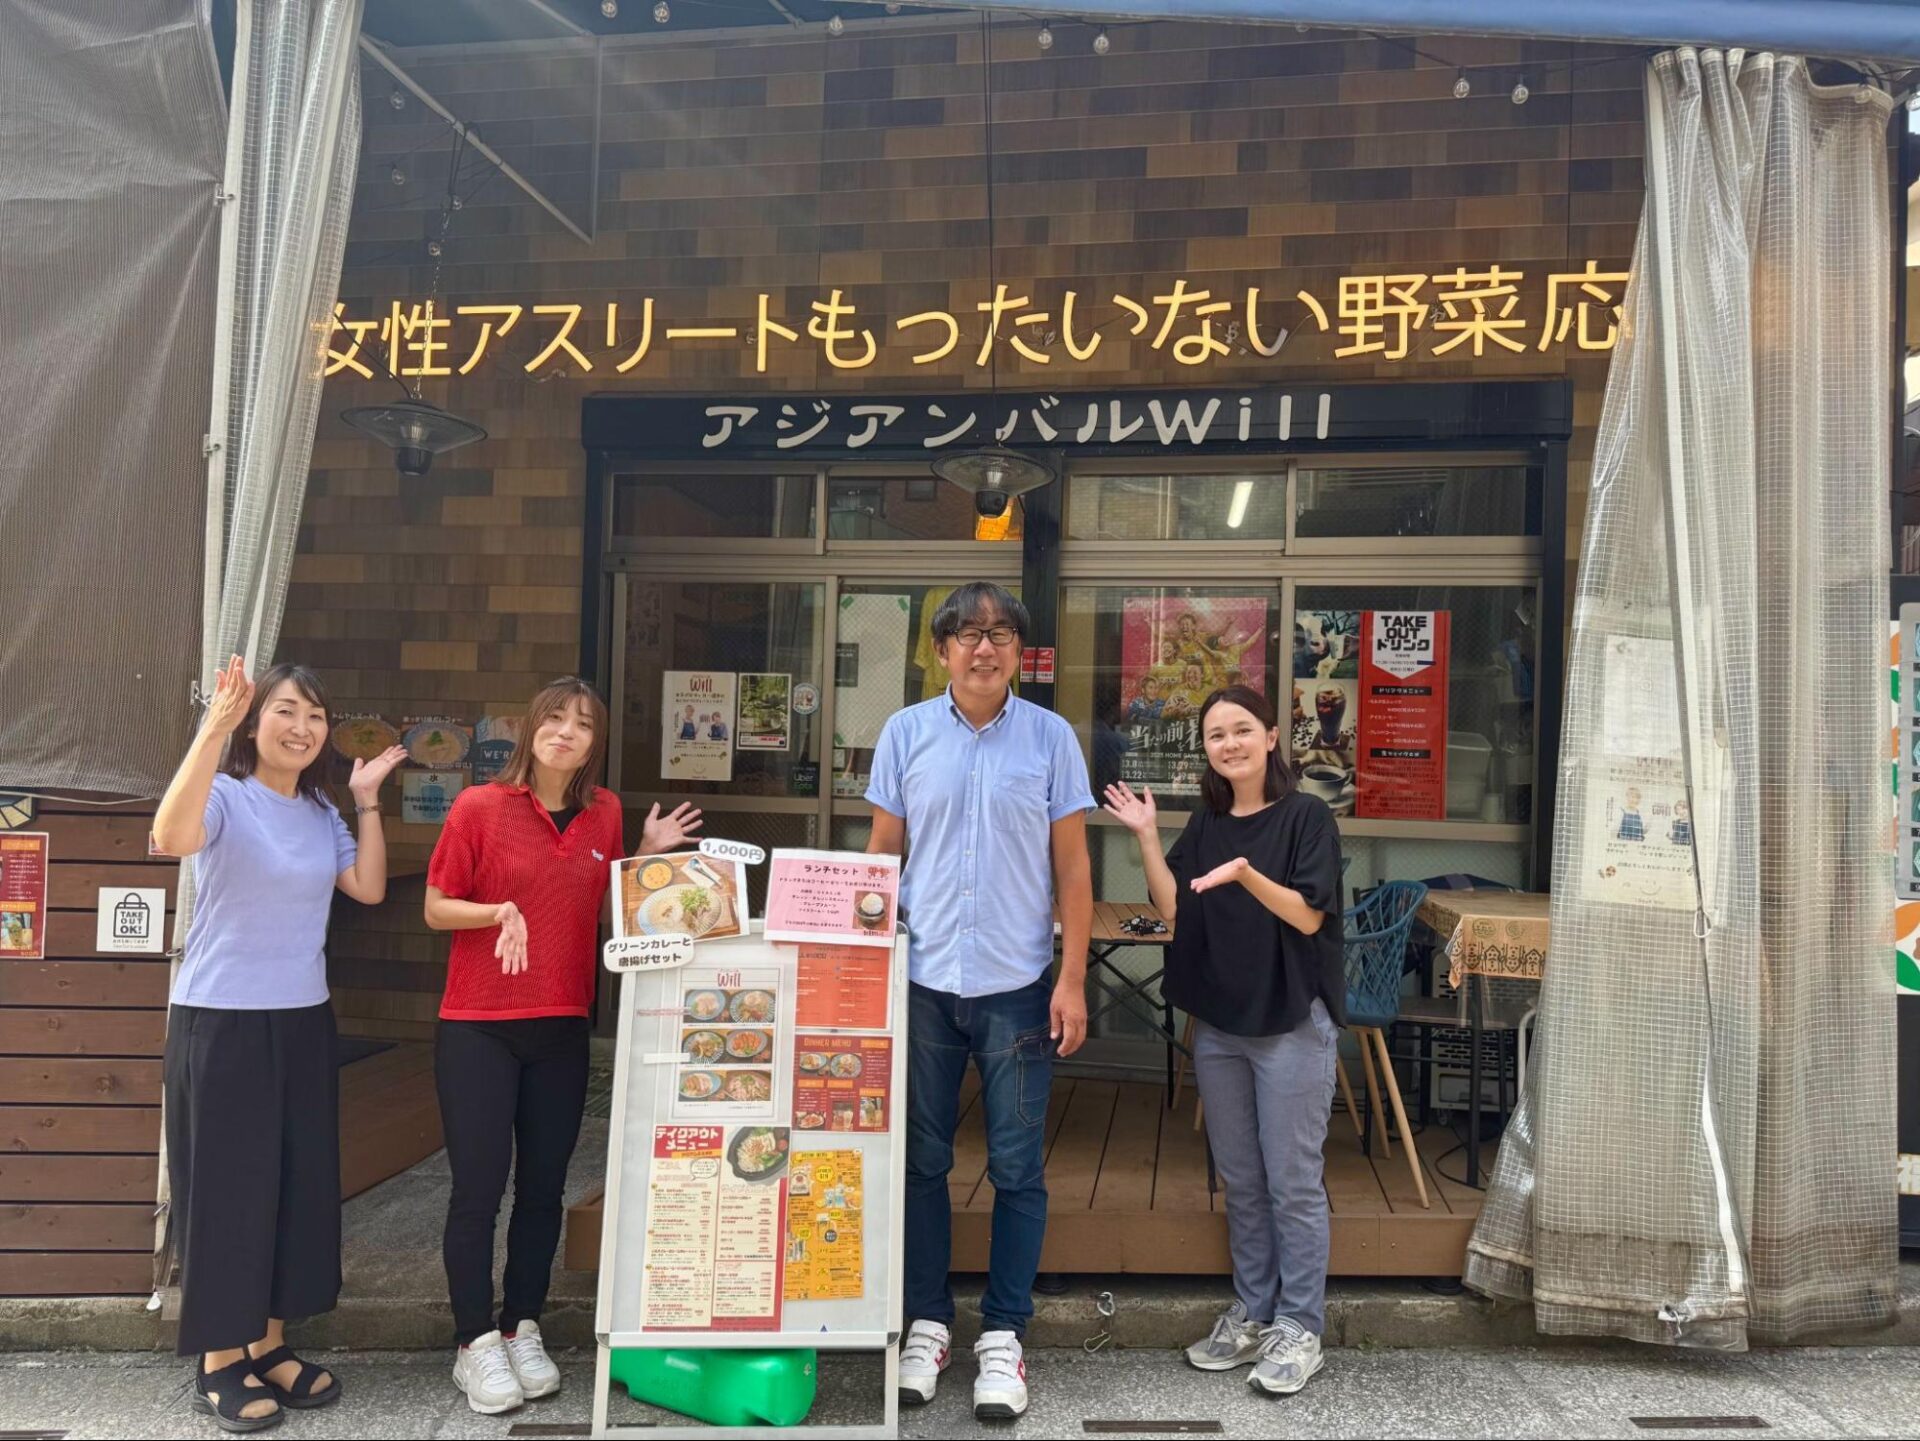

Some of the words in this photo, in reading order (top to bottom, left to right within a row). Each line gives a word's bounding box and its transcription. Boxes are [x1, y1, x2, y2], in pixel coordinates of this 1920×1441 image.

[1381, 615, 1427, 628] TAKE
[1386, 627, 1420, 640] OUT
[1377, 638, 1430, 651] ドリンク
[690, 678, 713, 693] Will
[484, 750, 511, 760] WE'R
[703, 841, 764, 861] 1,000円
[804, 864, 859, 876] ランチセット
[119, 925, 142, 934] OK!
[608, 937, 691, 953] グリーンカレーと
[619, 953, 682, 967] 唐揚げセット
[717, 972, 741, 988] Will
[656, 1128, 718, 1139] テイクアウト
[666, 1140, 709, 1150] メニュー
